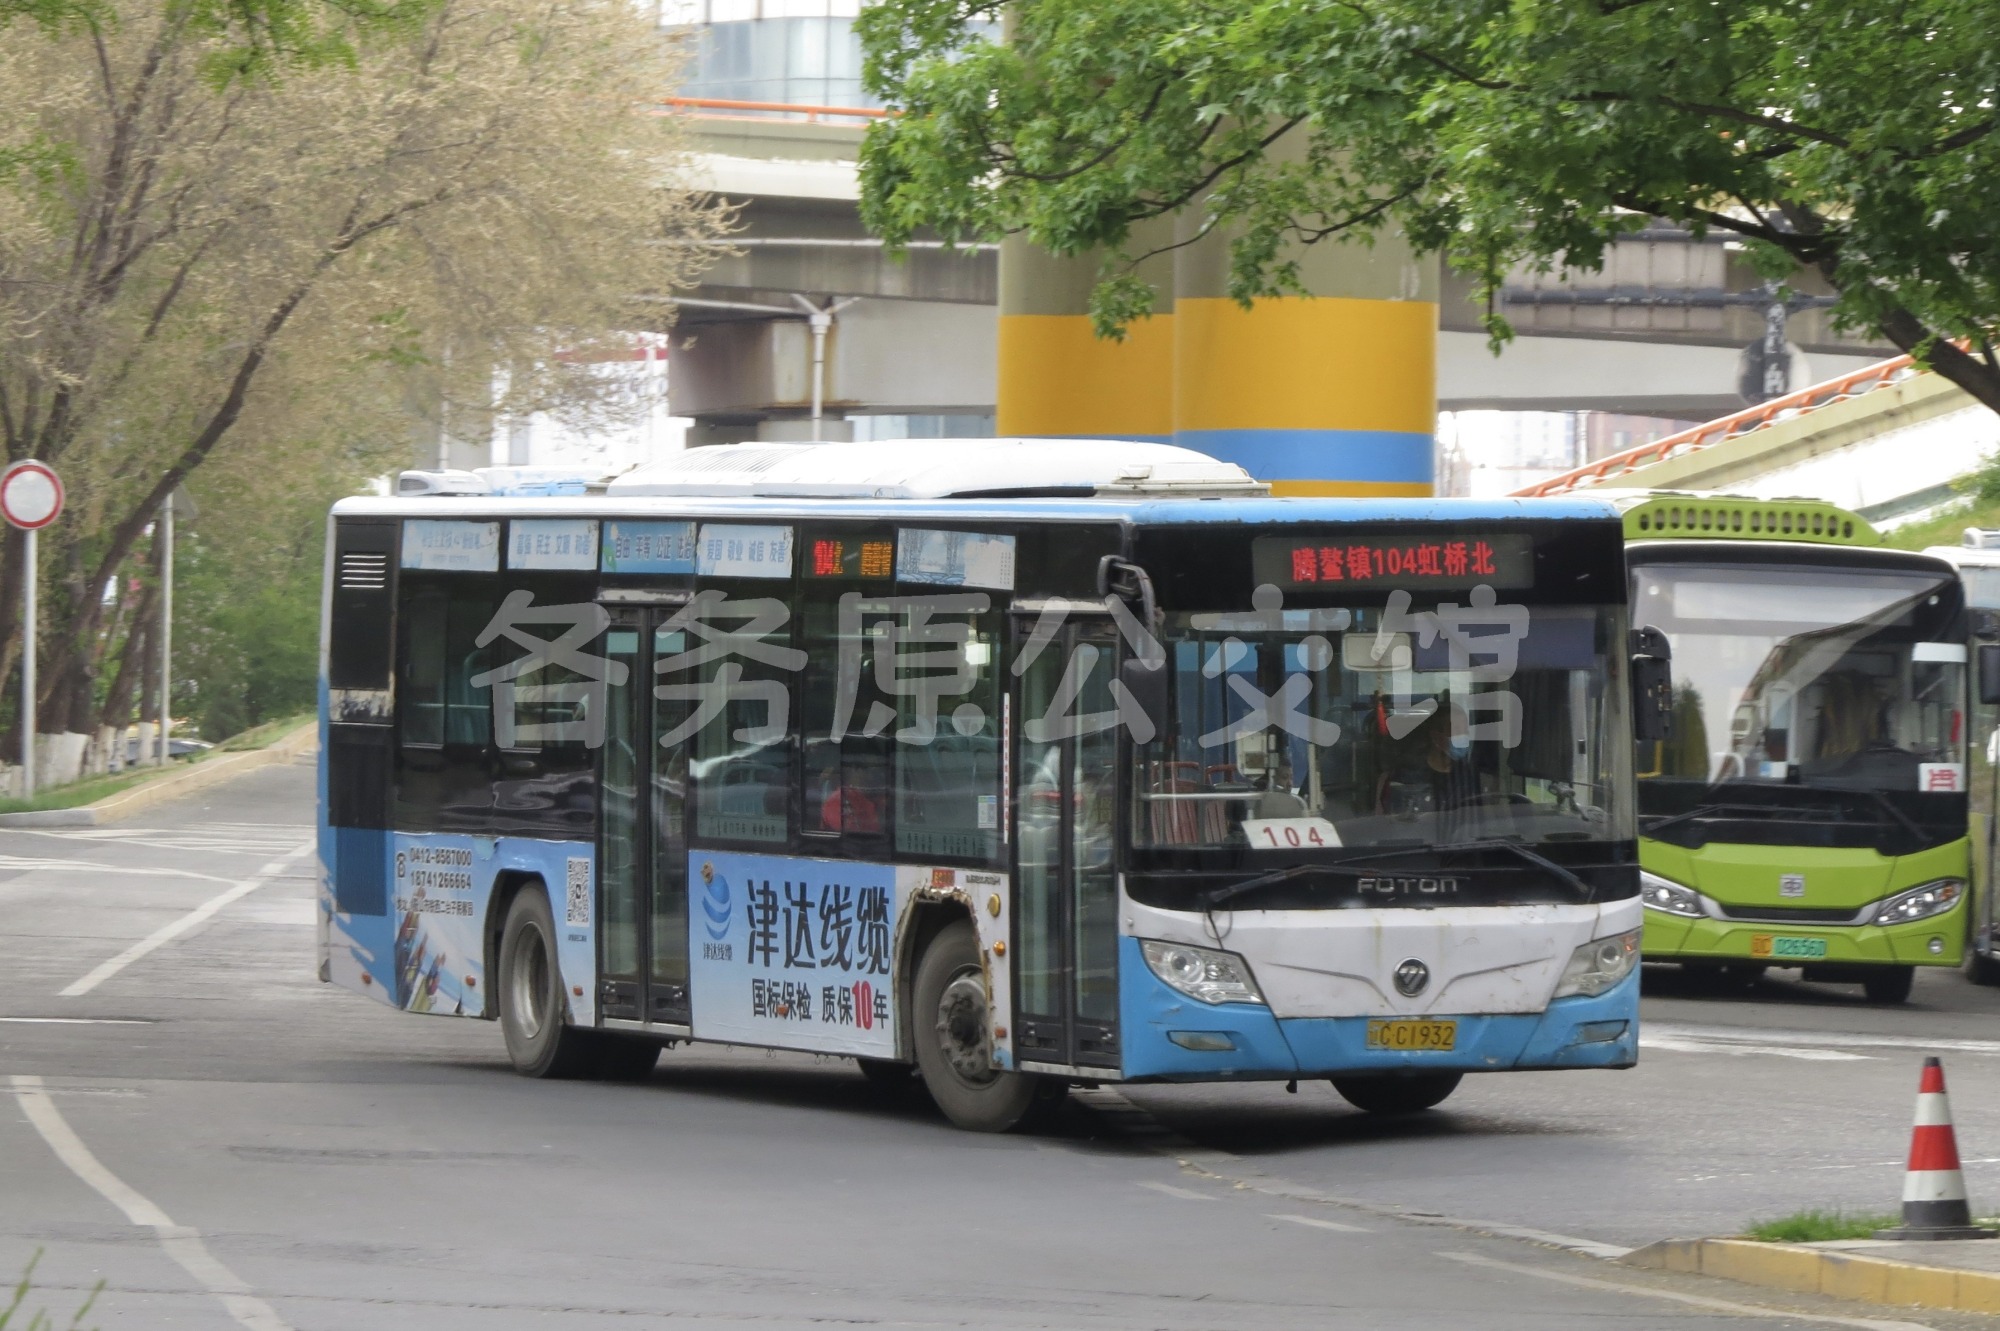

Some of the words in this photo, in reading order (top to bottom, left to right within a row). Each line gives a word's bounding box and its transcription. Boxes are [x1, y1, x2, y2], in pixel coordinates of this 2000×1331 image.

[615, 535, 631, 559] 自由
[636, 535, 652, 560] 平等
[657, 535, 672, 560] 公正
[1291, 541, 1496, 583] 腾鳌镇104虹桥北
[1262, 826, 1324, 848] 104
[1357, 877, 1458, 894] FOTON
[746, 879, 891, 975] 津达线缆
[703, 942, 733, 961] 津达线缆
[822, 980, 889, 1030] 质保10年
